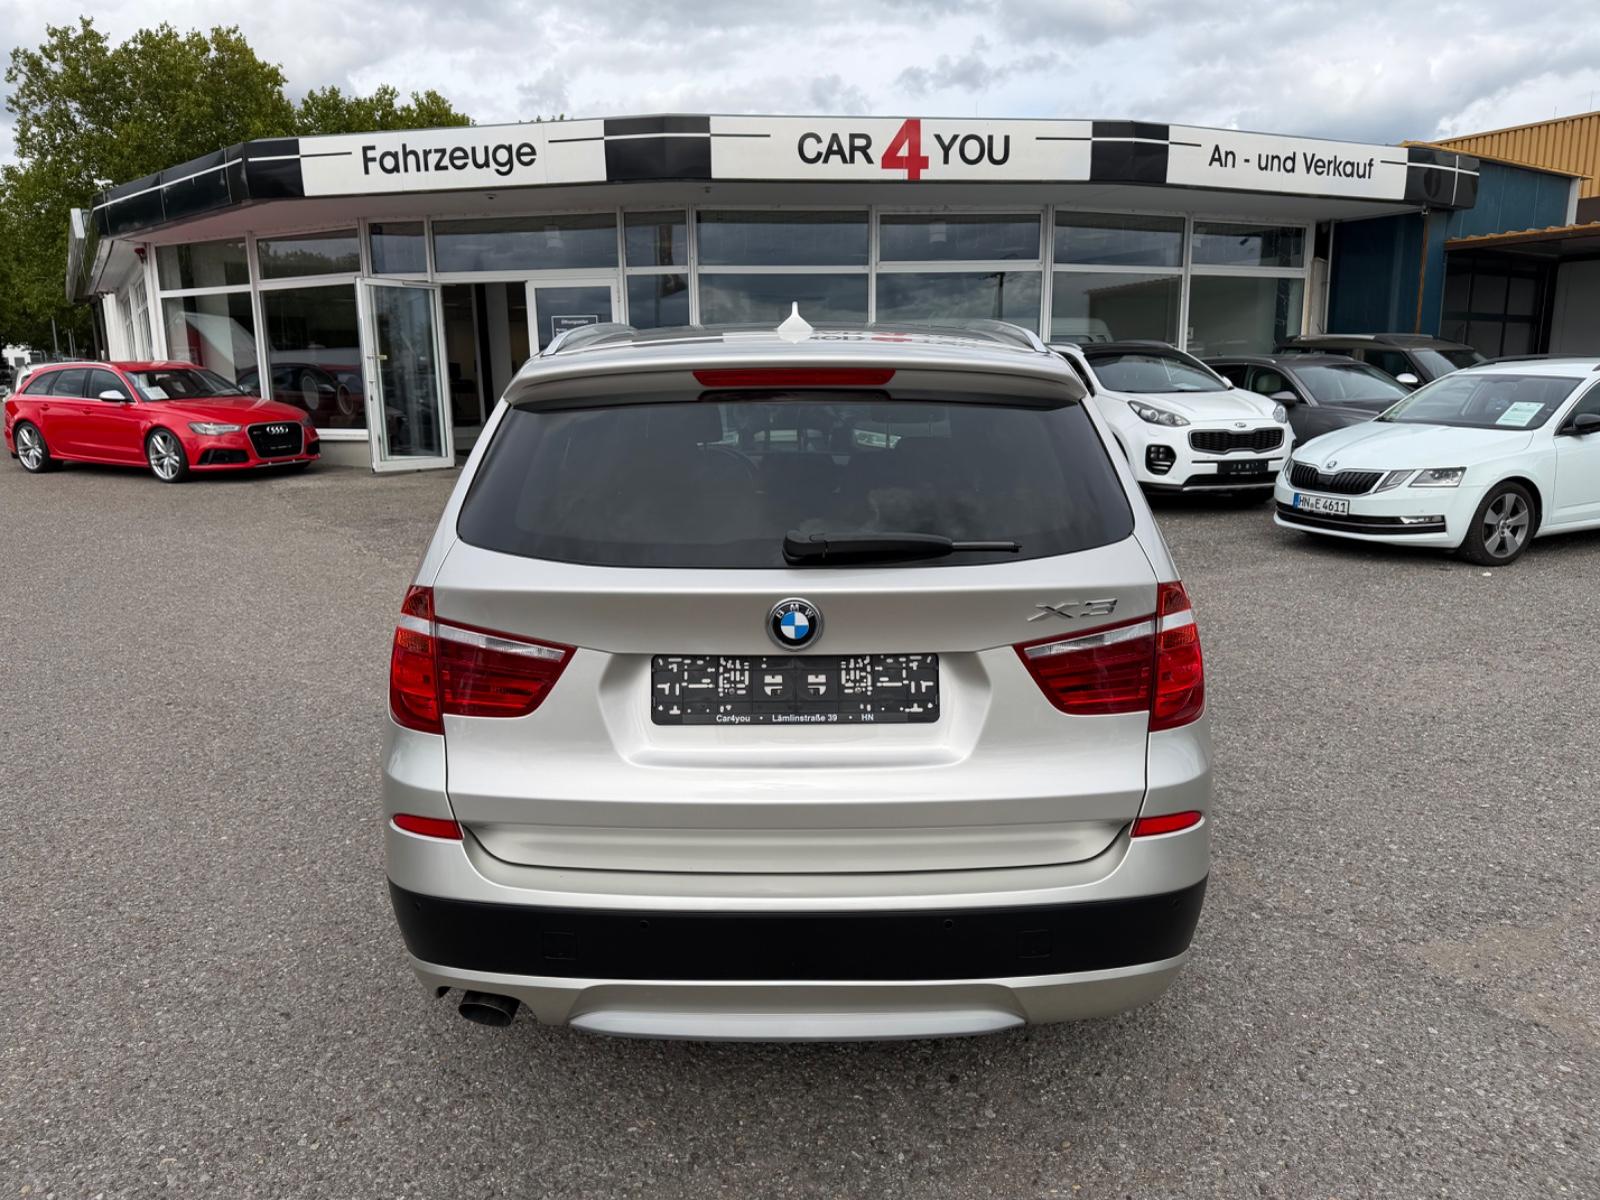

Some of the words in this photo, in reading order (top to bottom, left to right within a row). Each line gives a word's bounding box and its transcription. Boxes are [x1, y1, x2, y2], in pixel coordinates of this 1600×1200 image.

[361, 142, 537, 176] Fahrzeuge
[1257, 152, 1296, 173] und
[1303, 152, 1374, 179] Verkauf
[1322, 500, 1346, 513] 4611
[775, 603, 814, 619] BMW
[1027, 598, 1117, 621] X3
[716, 714, 751, 724] Car4you
[827, 713, 838, 722] 39
[861, 713, 874, 721] HN
